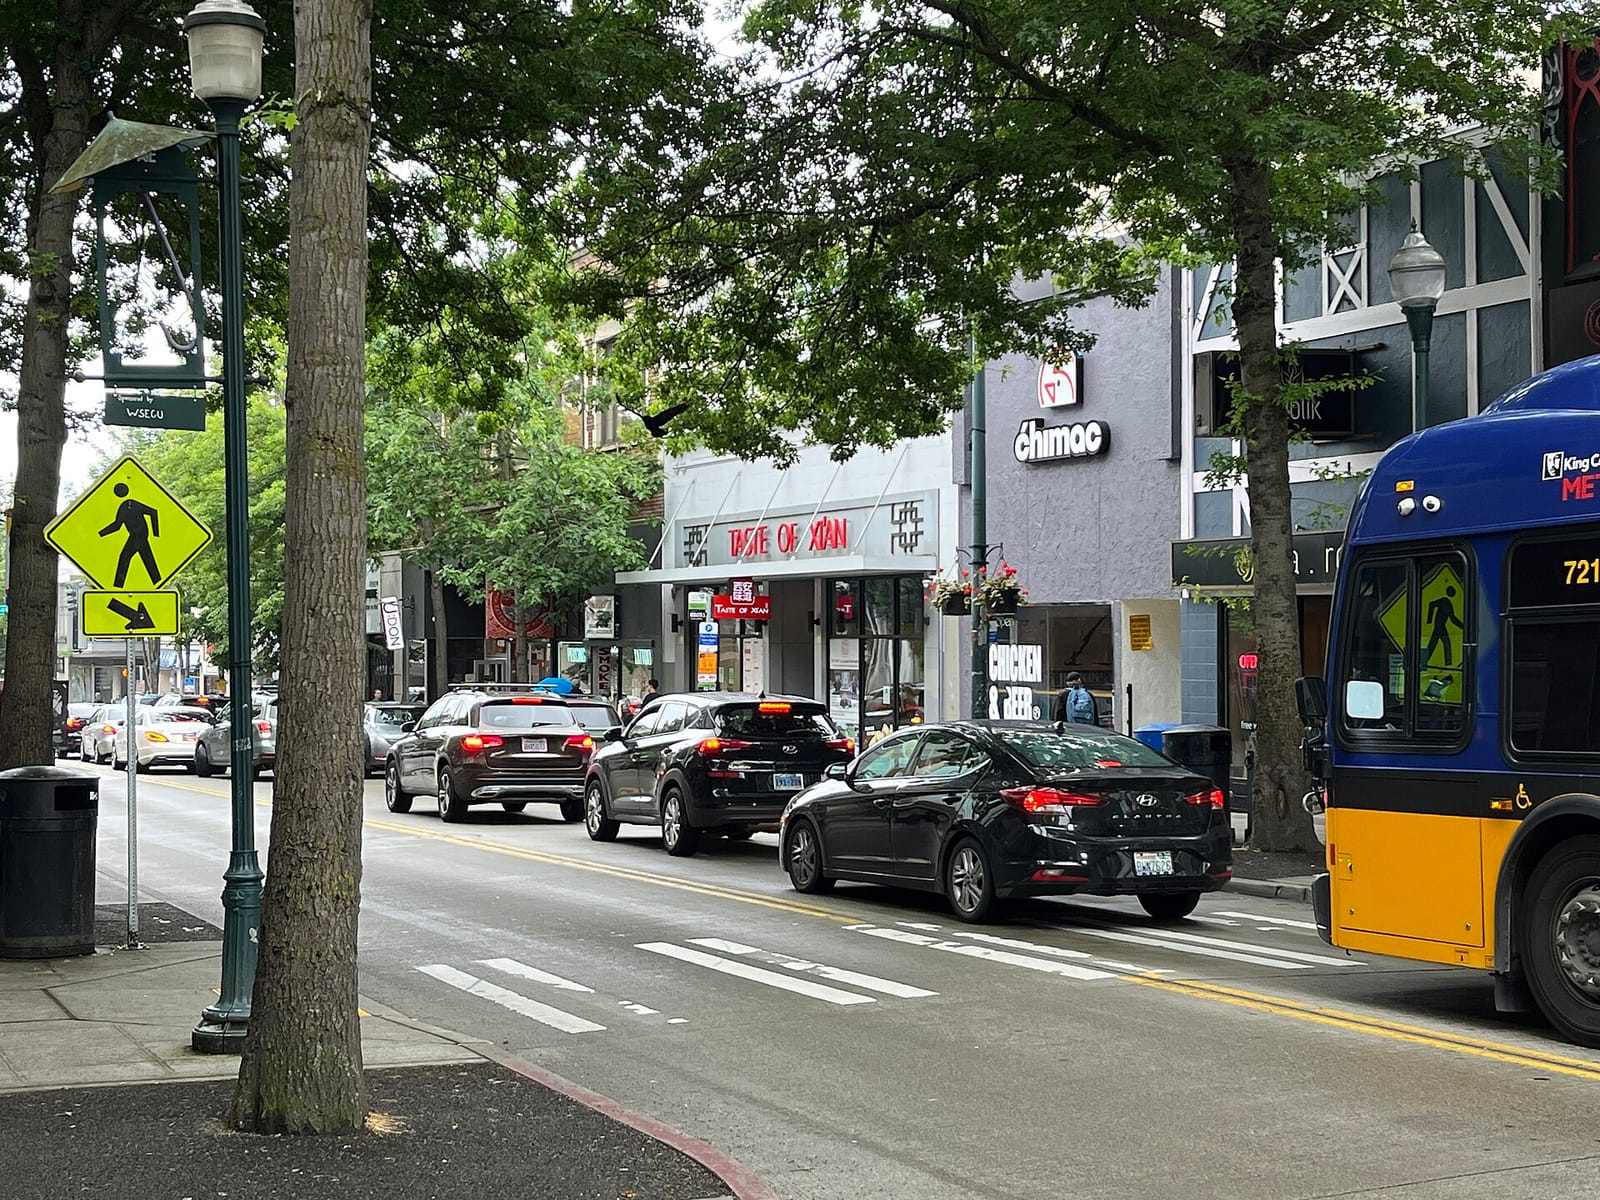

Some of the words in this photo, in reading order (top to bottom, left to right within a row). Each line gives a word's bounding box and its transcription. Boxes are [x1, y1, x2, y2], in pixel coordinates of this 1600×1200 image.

[1563, 456, 1590, 472] King
[1561, 474, 1600, 501] ME
[728, 525, 768, 557] TASTE
[778, 522, 799, 553] OF
[714, 604, 736, 614] TASTE
[598, 647, 611, 690] SMOKE
[988, 643, 1042, 683] CHICKEN
[988, 685, 1001, 720] &
[1003, 685, 1033, 720] BEER
